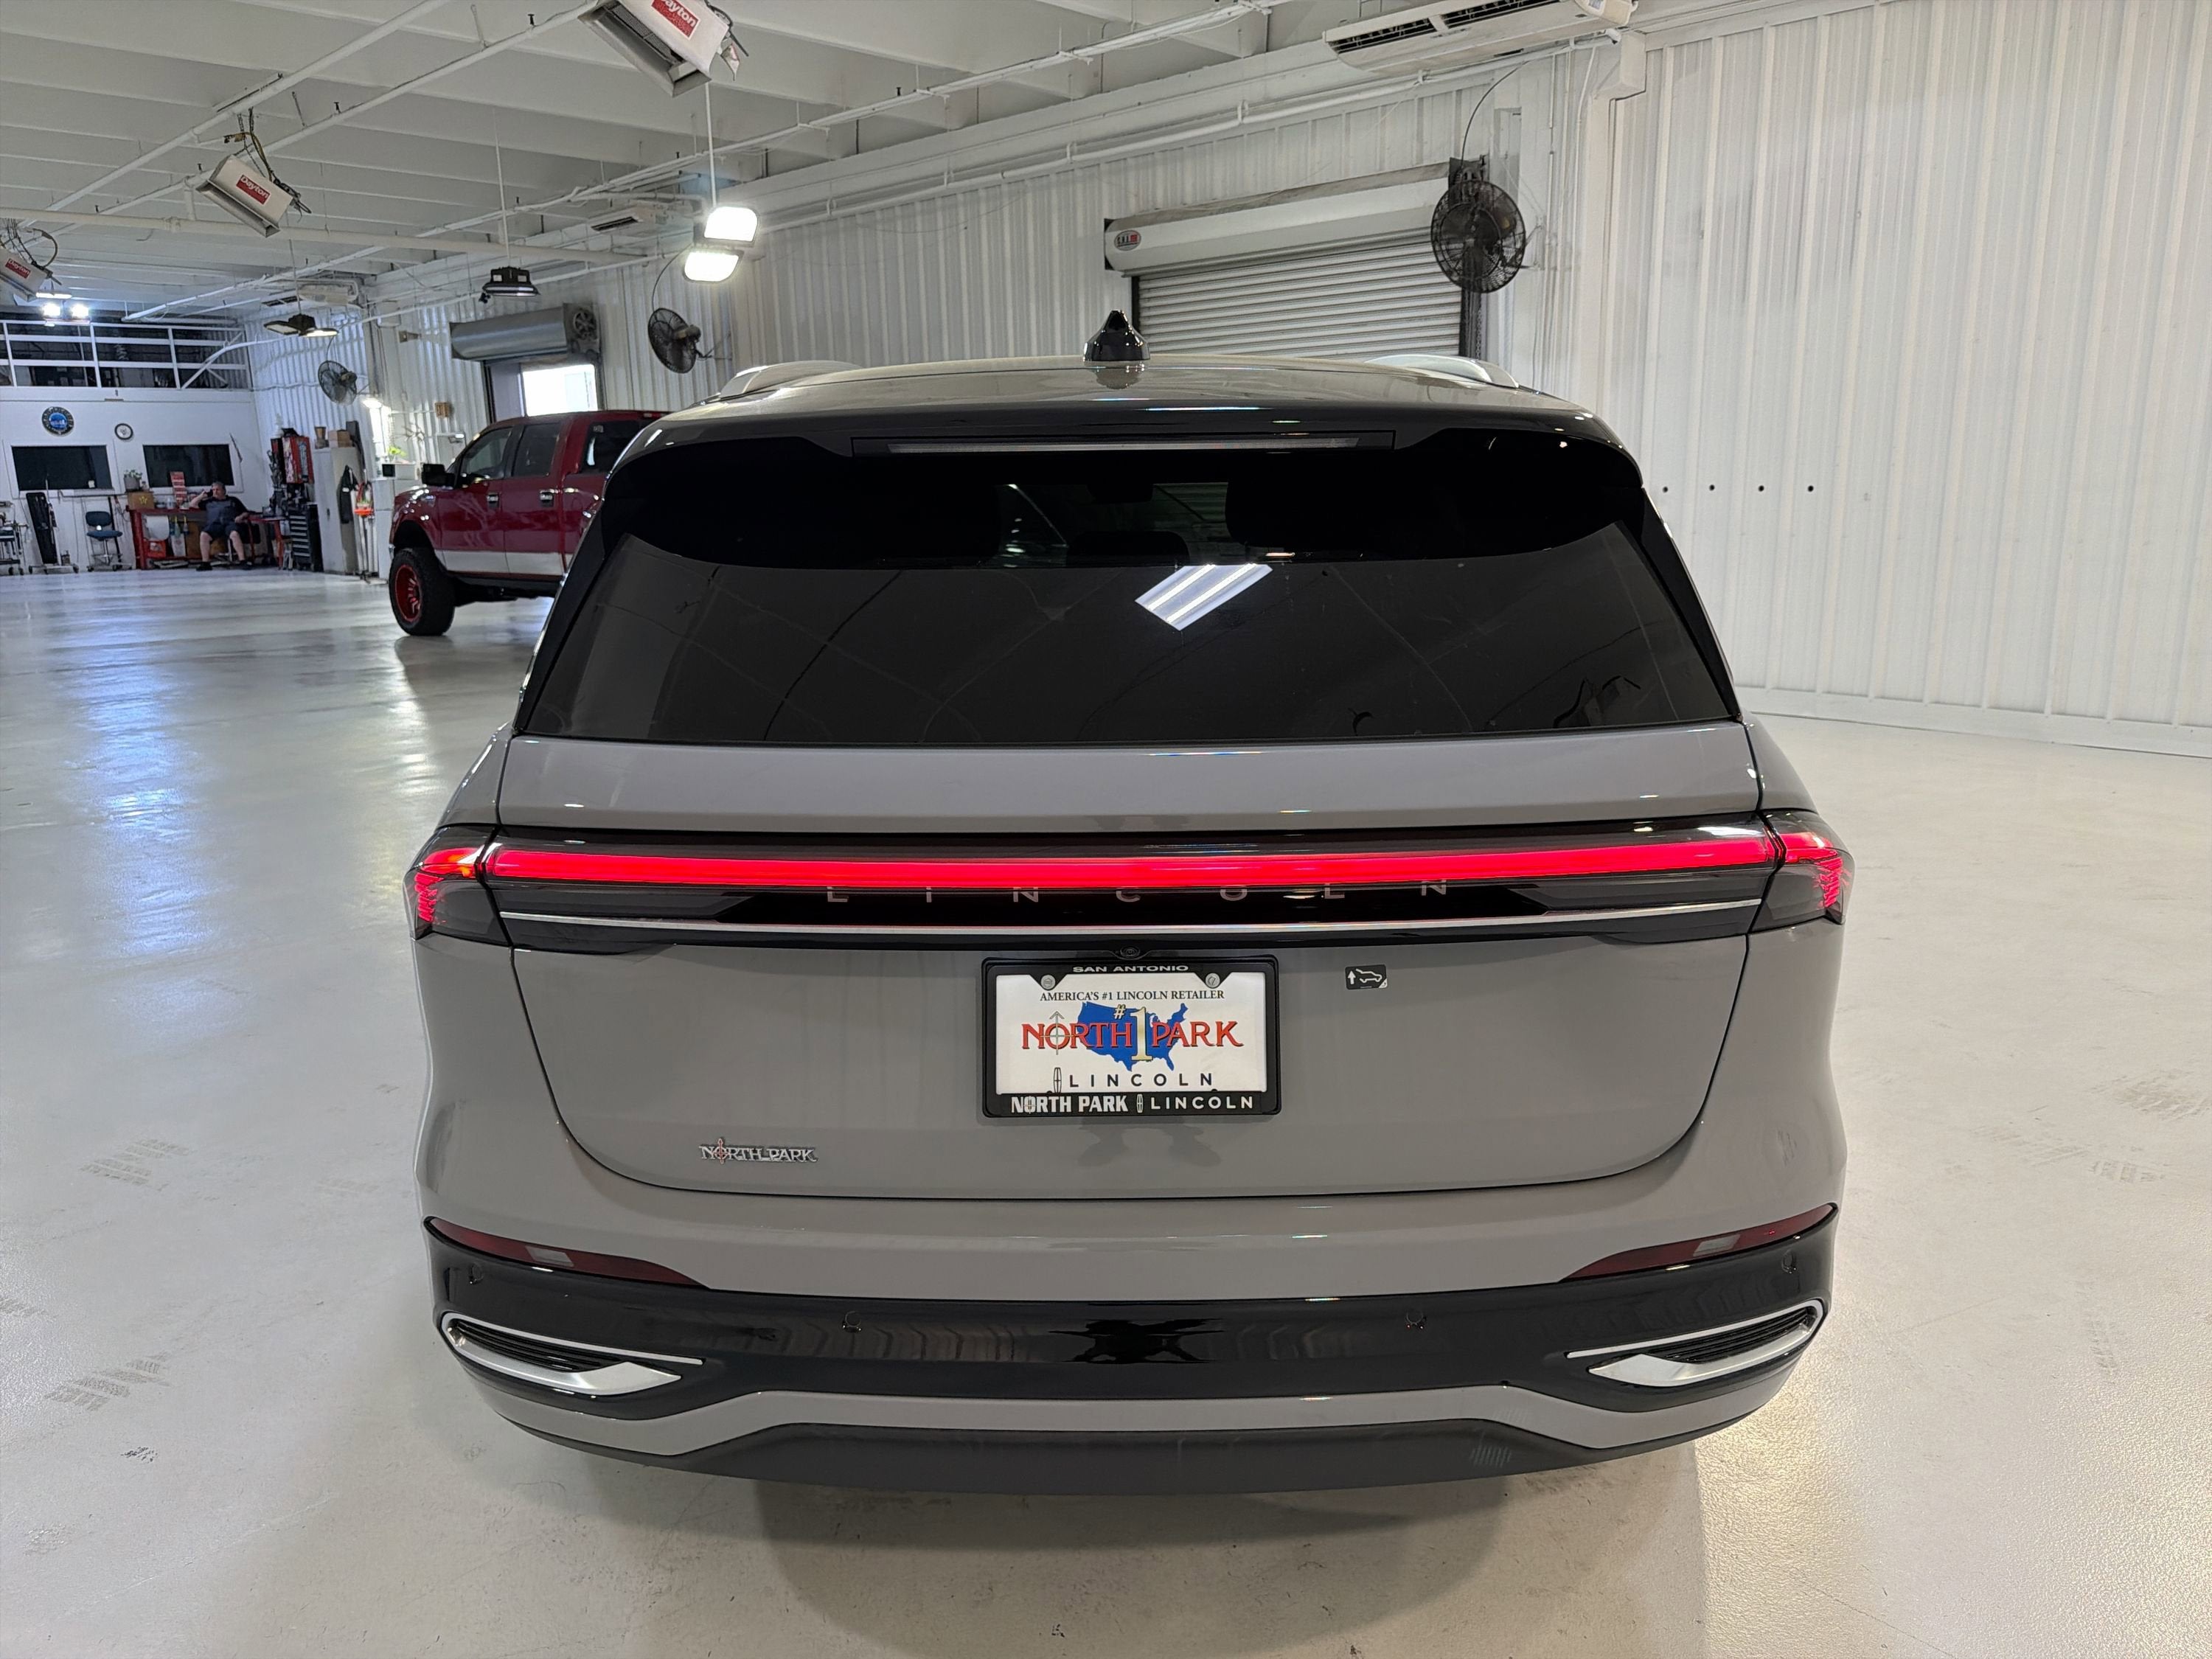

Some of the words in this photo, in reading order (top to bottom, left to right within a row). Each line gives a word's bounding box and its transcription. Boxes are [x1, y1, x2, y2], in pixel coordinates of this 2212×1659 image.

[661, 0, 696, 27] ayton
[240, 177, 269, 198] Dayton
[827, 879, 1447, 903] LINCOLN
[1040, 992, 1099, 1001] AMERICA'S
[1102, 992, 1113, 1001] #1
[1116, 991, 1168, 1000] LINCOLN
[1171, 990, 1225, 999] RETAILER
[1021, 1022, 1133, 1050] NORTH
[1151, 1020, 1245, 1047] PARK
[1069, 1073, 1212, 1088] LINCOLN
[1011, 1095, 1072, 1114] NORTH
[1078, 1095, 1129, 1113] PARK
[1150, 1096, 1253, 1110] LINCOLN
